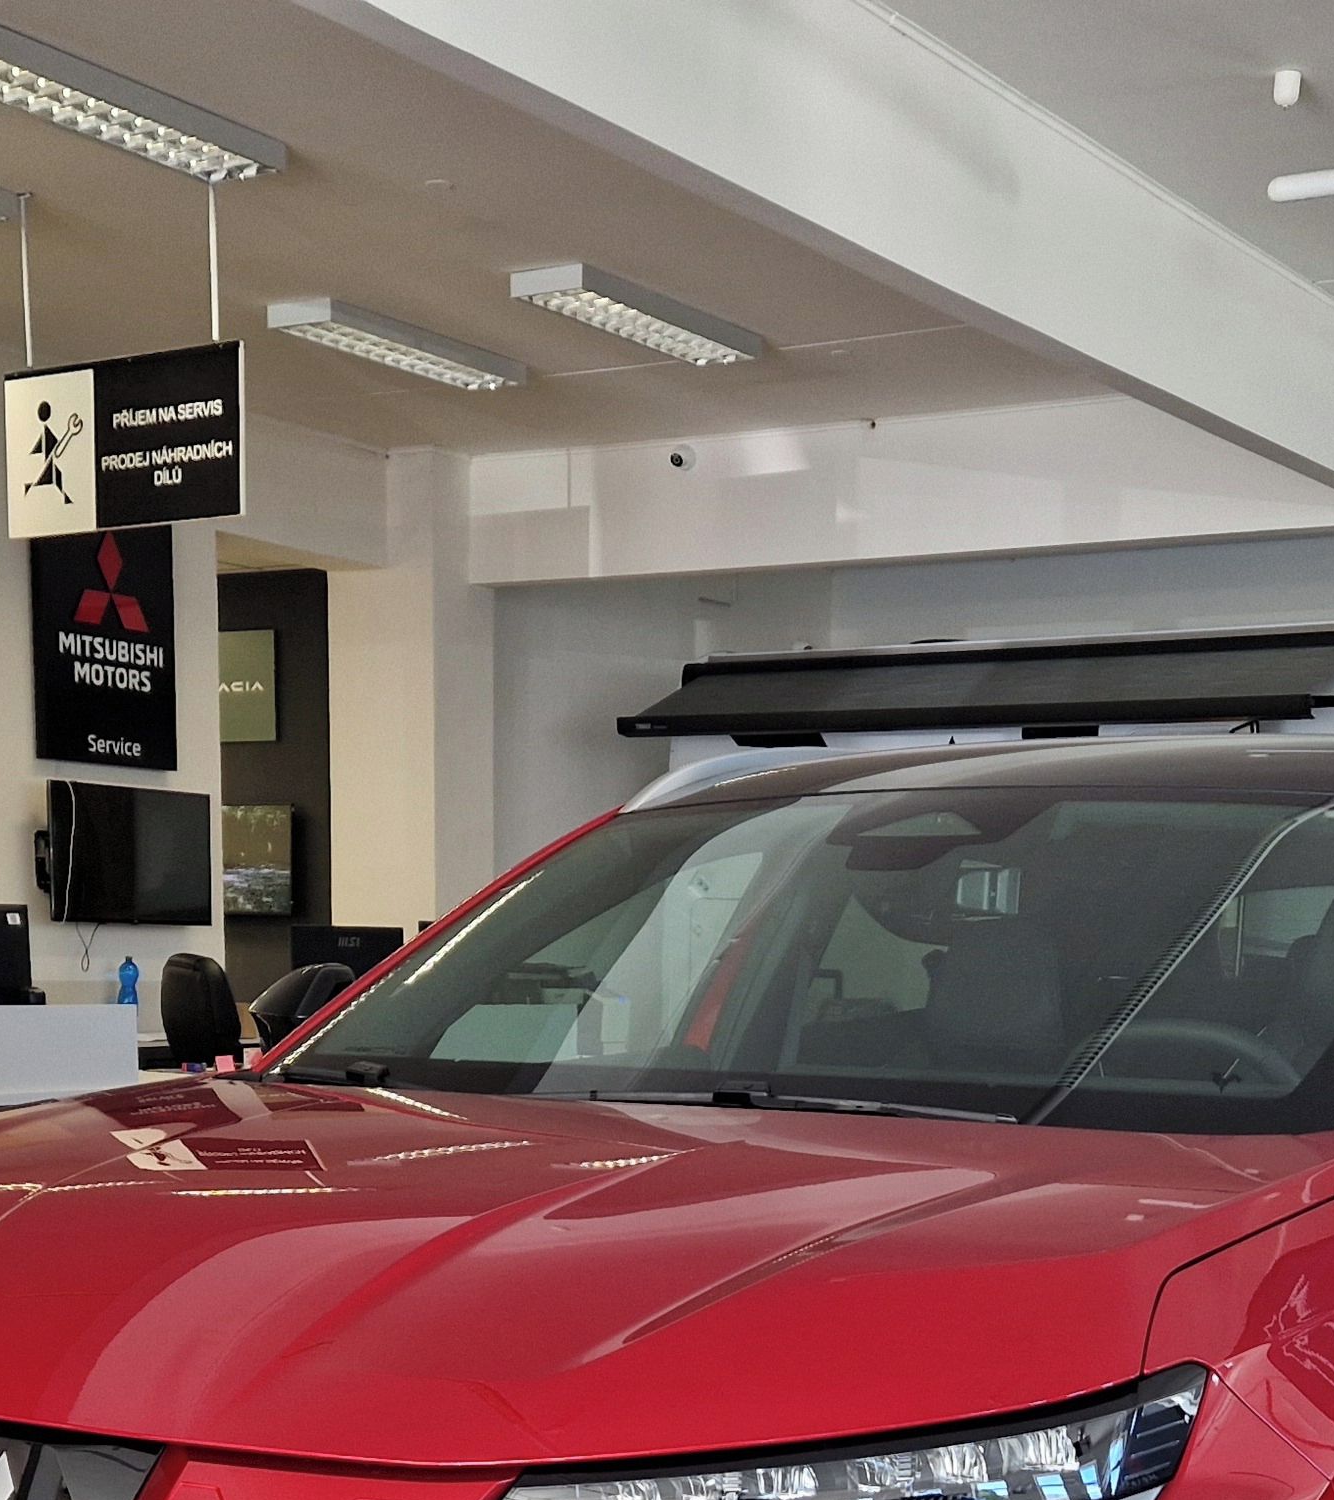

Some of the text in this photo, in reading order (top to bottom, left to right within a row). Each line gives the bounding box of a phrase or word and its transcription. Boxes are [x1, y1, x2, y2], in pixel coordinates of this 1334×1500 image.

[113, 398, 224, 430] PŘÍJEM NA SERVIS
[101, 440, 233, 471] PRODEJ NÁHRADNÍCH
[154, 468, 183, 487] DÍLŮ
[58, 631, 164, 669] MITSUBISHI
[74, 661, 152, 693] MOTORS
[217, 680, 264, 692] ACIA
[87, 734, 142, 756] Service
